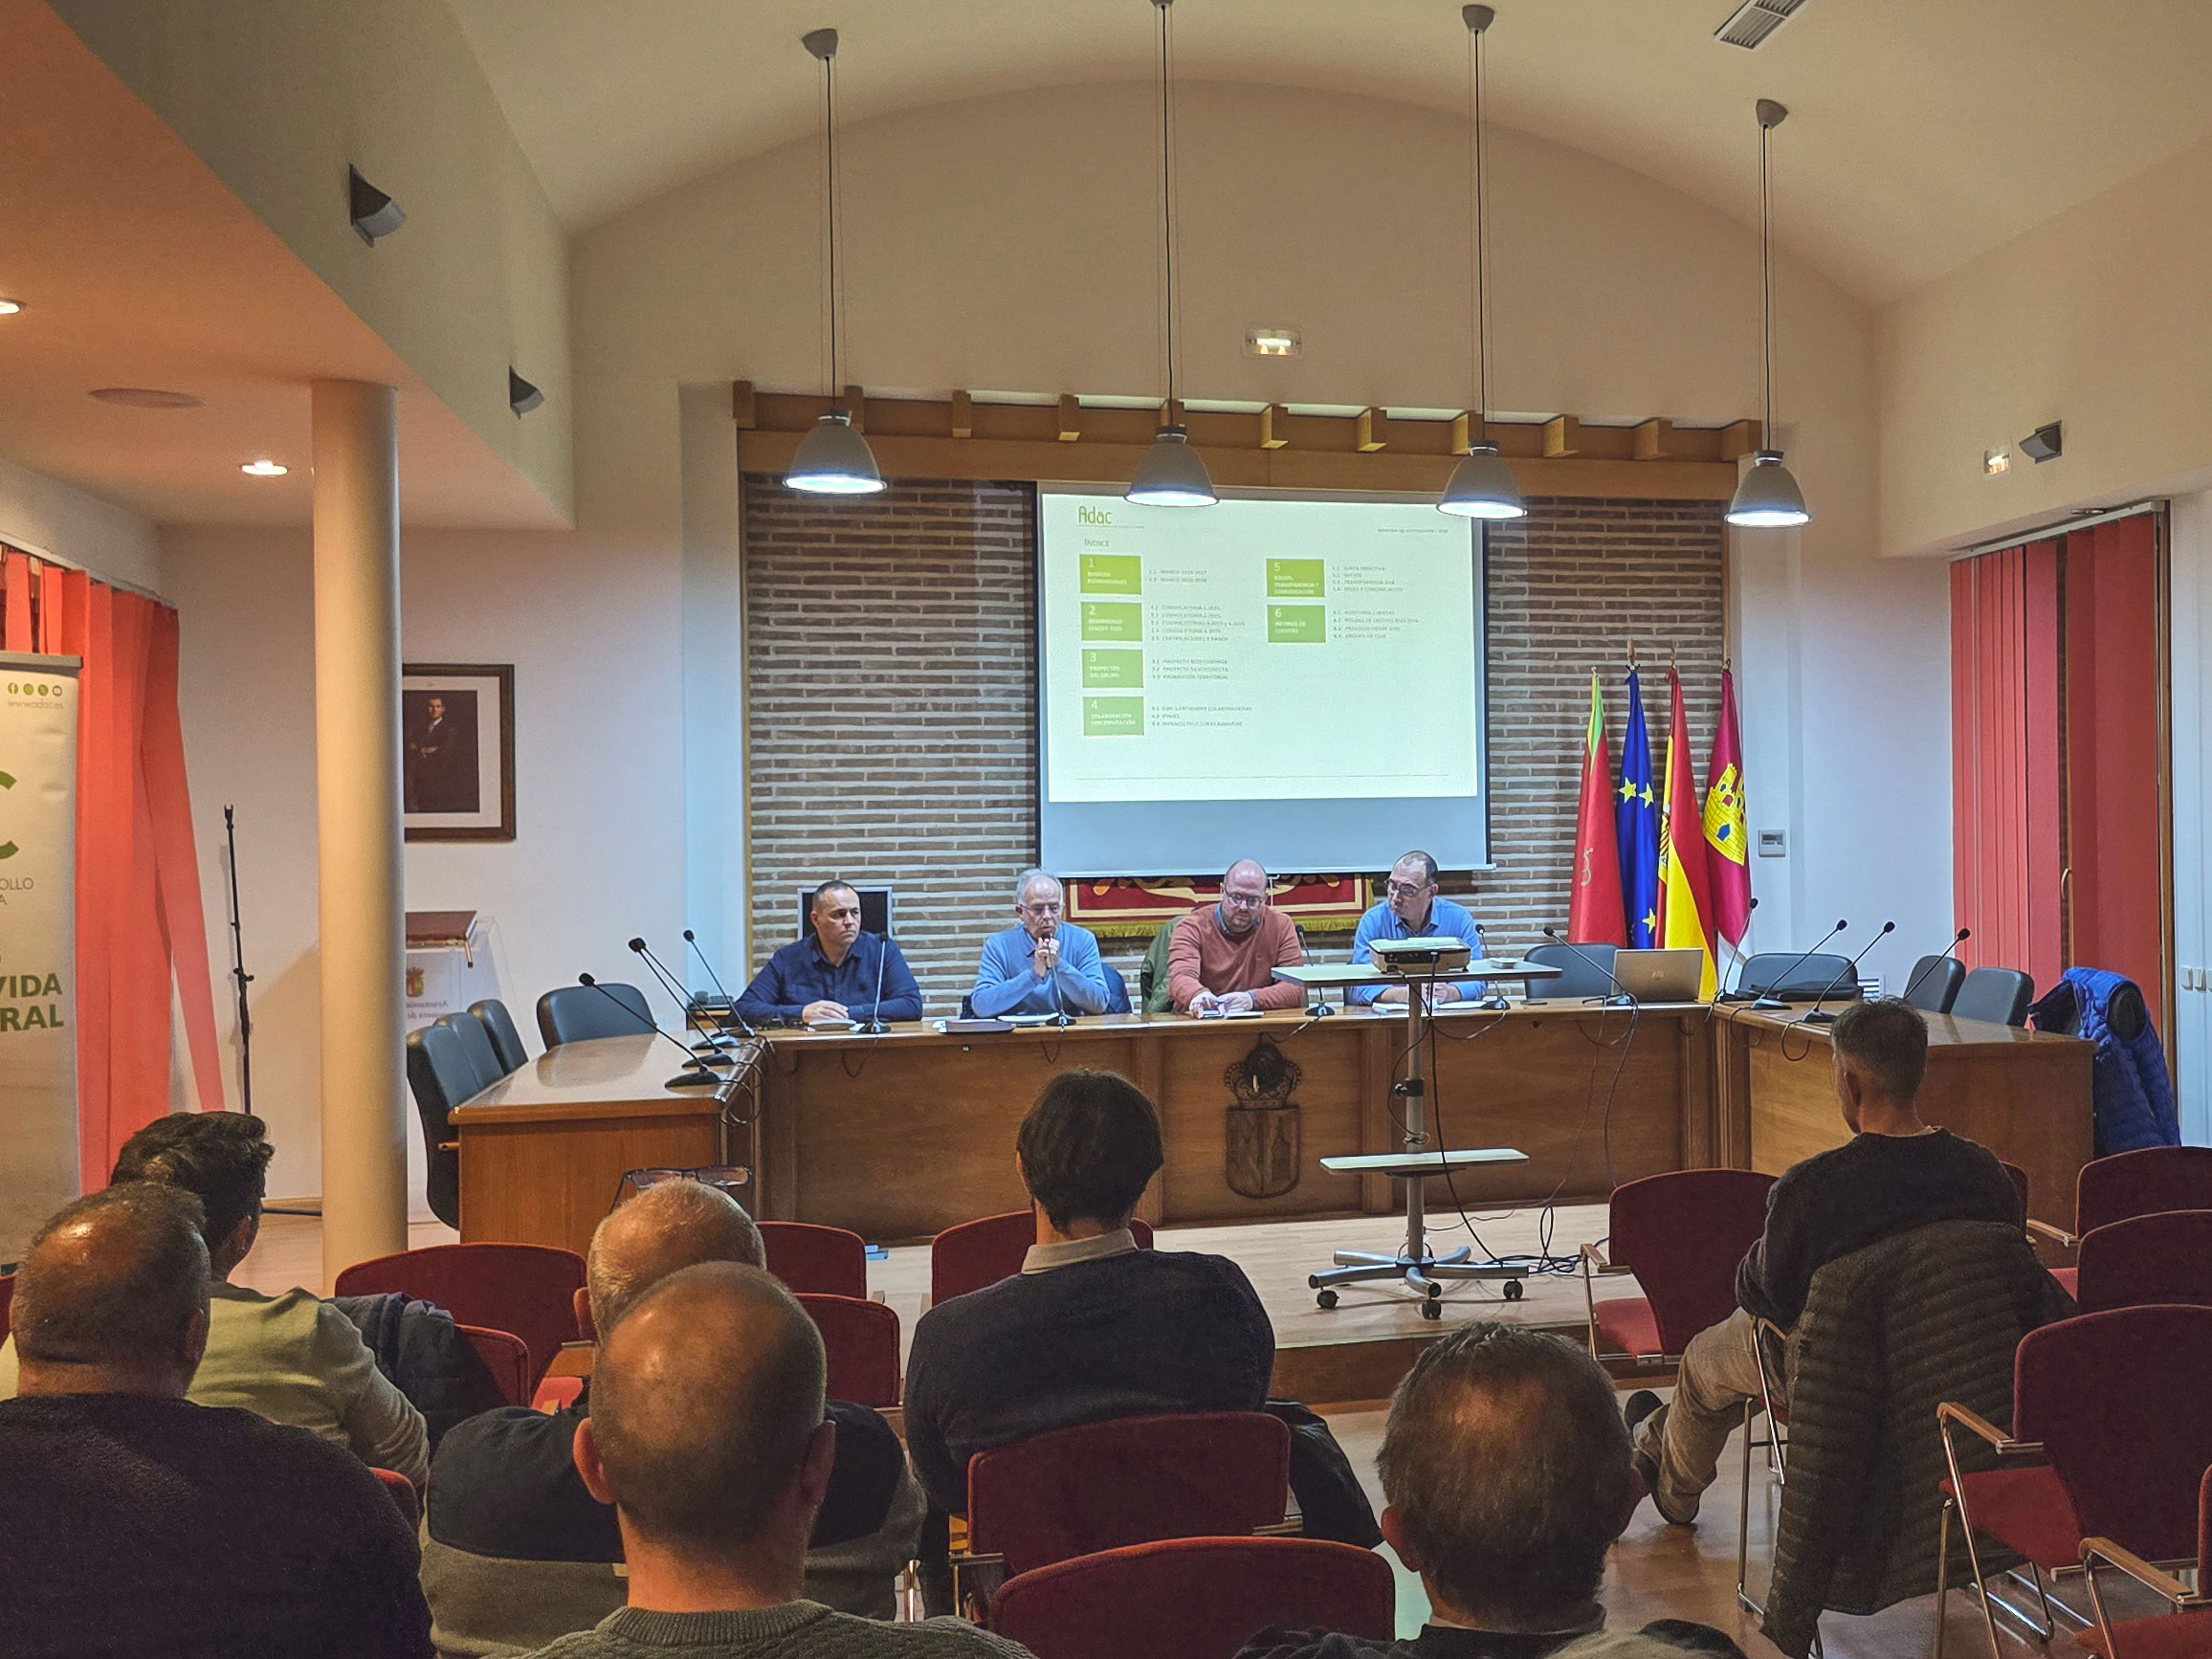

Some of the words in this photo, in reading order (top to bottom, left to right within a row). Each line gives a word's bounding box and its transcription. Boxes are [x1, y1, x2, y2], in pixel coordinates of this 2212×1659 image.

[1078, 505, 1112, 524] Adac
[1084, 539, 1110, 547] ÍNDICE
[1088, 558, 1095, 568] 1
[1273, 562, 1281, 572] 5
[1089, 605, 1096, 615] 2
[1274, 608, 1282, 618] 6
[1090, 653, 1097, 662] 3
[1091, 699, 1098, 710] 4
